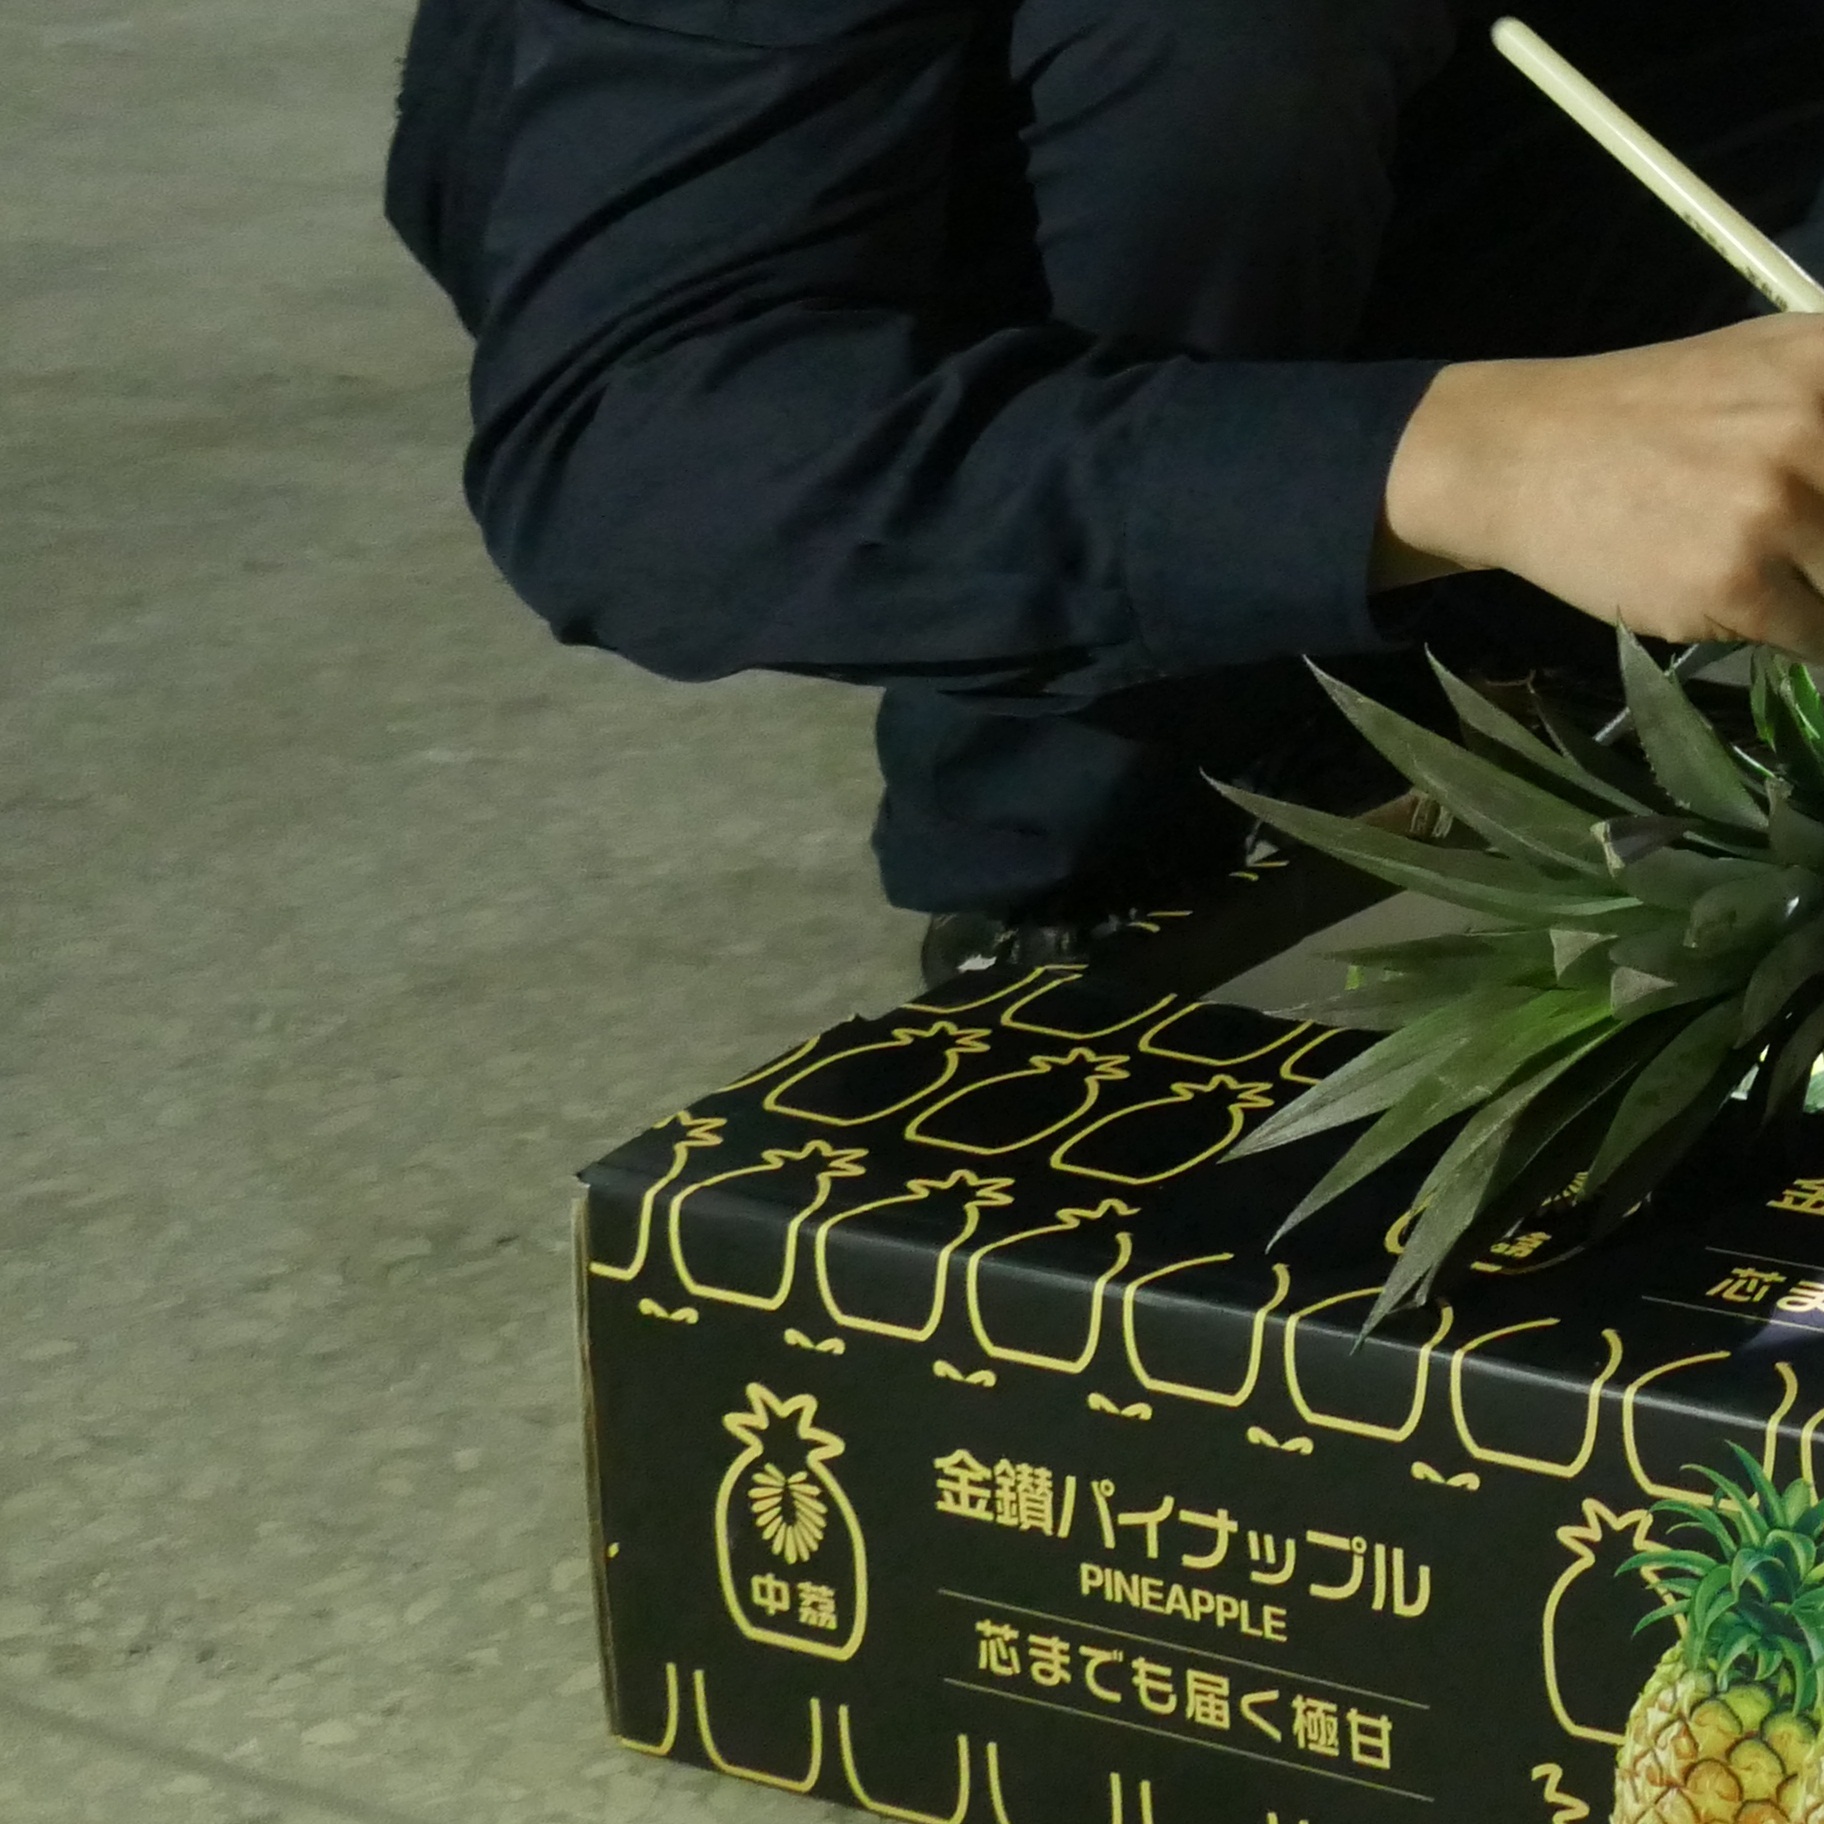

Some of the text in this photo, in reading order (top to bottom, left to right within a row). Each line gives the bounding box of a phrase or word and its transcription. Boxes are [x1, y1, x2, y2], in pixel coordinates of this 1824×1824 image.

[750, 1572, 838, 1630] 中荔
[1079, 1563, 1289, 1642] PINEAPPLE
[974, 1619, 1394, 1770] 芯までも届く極甘
